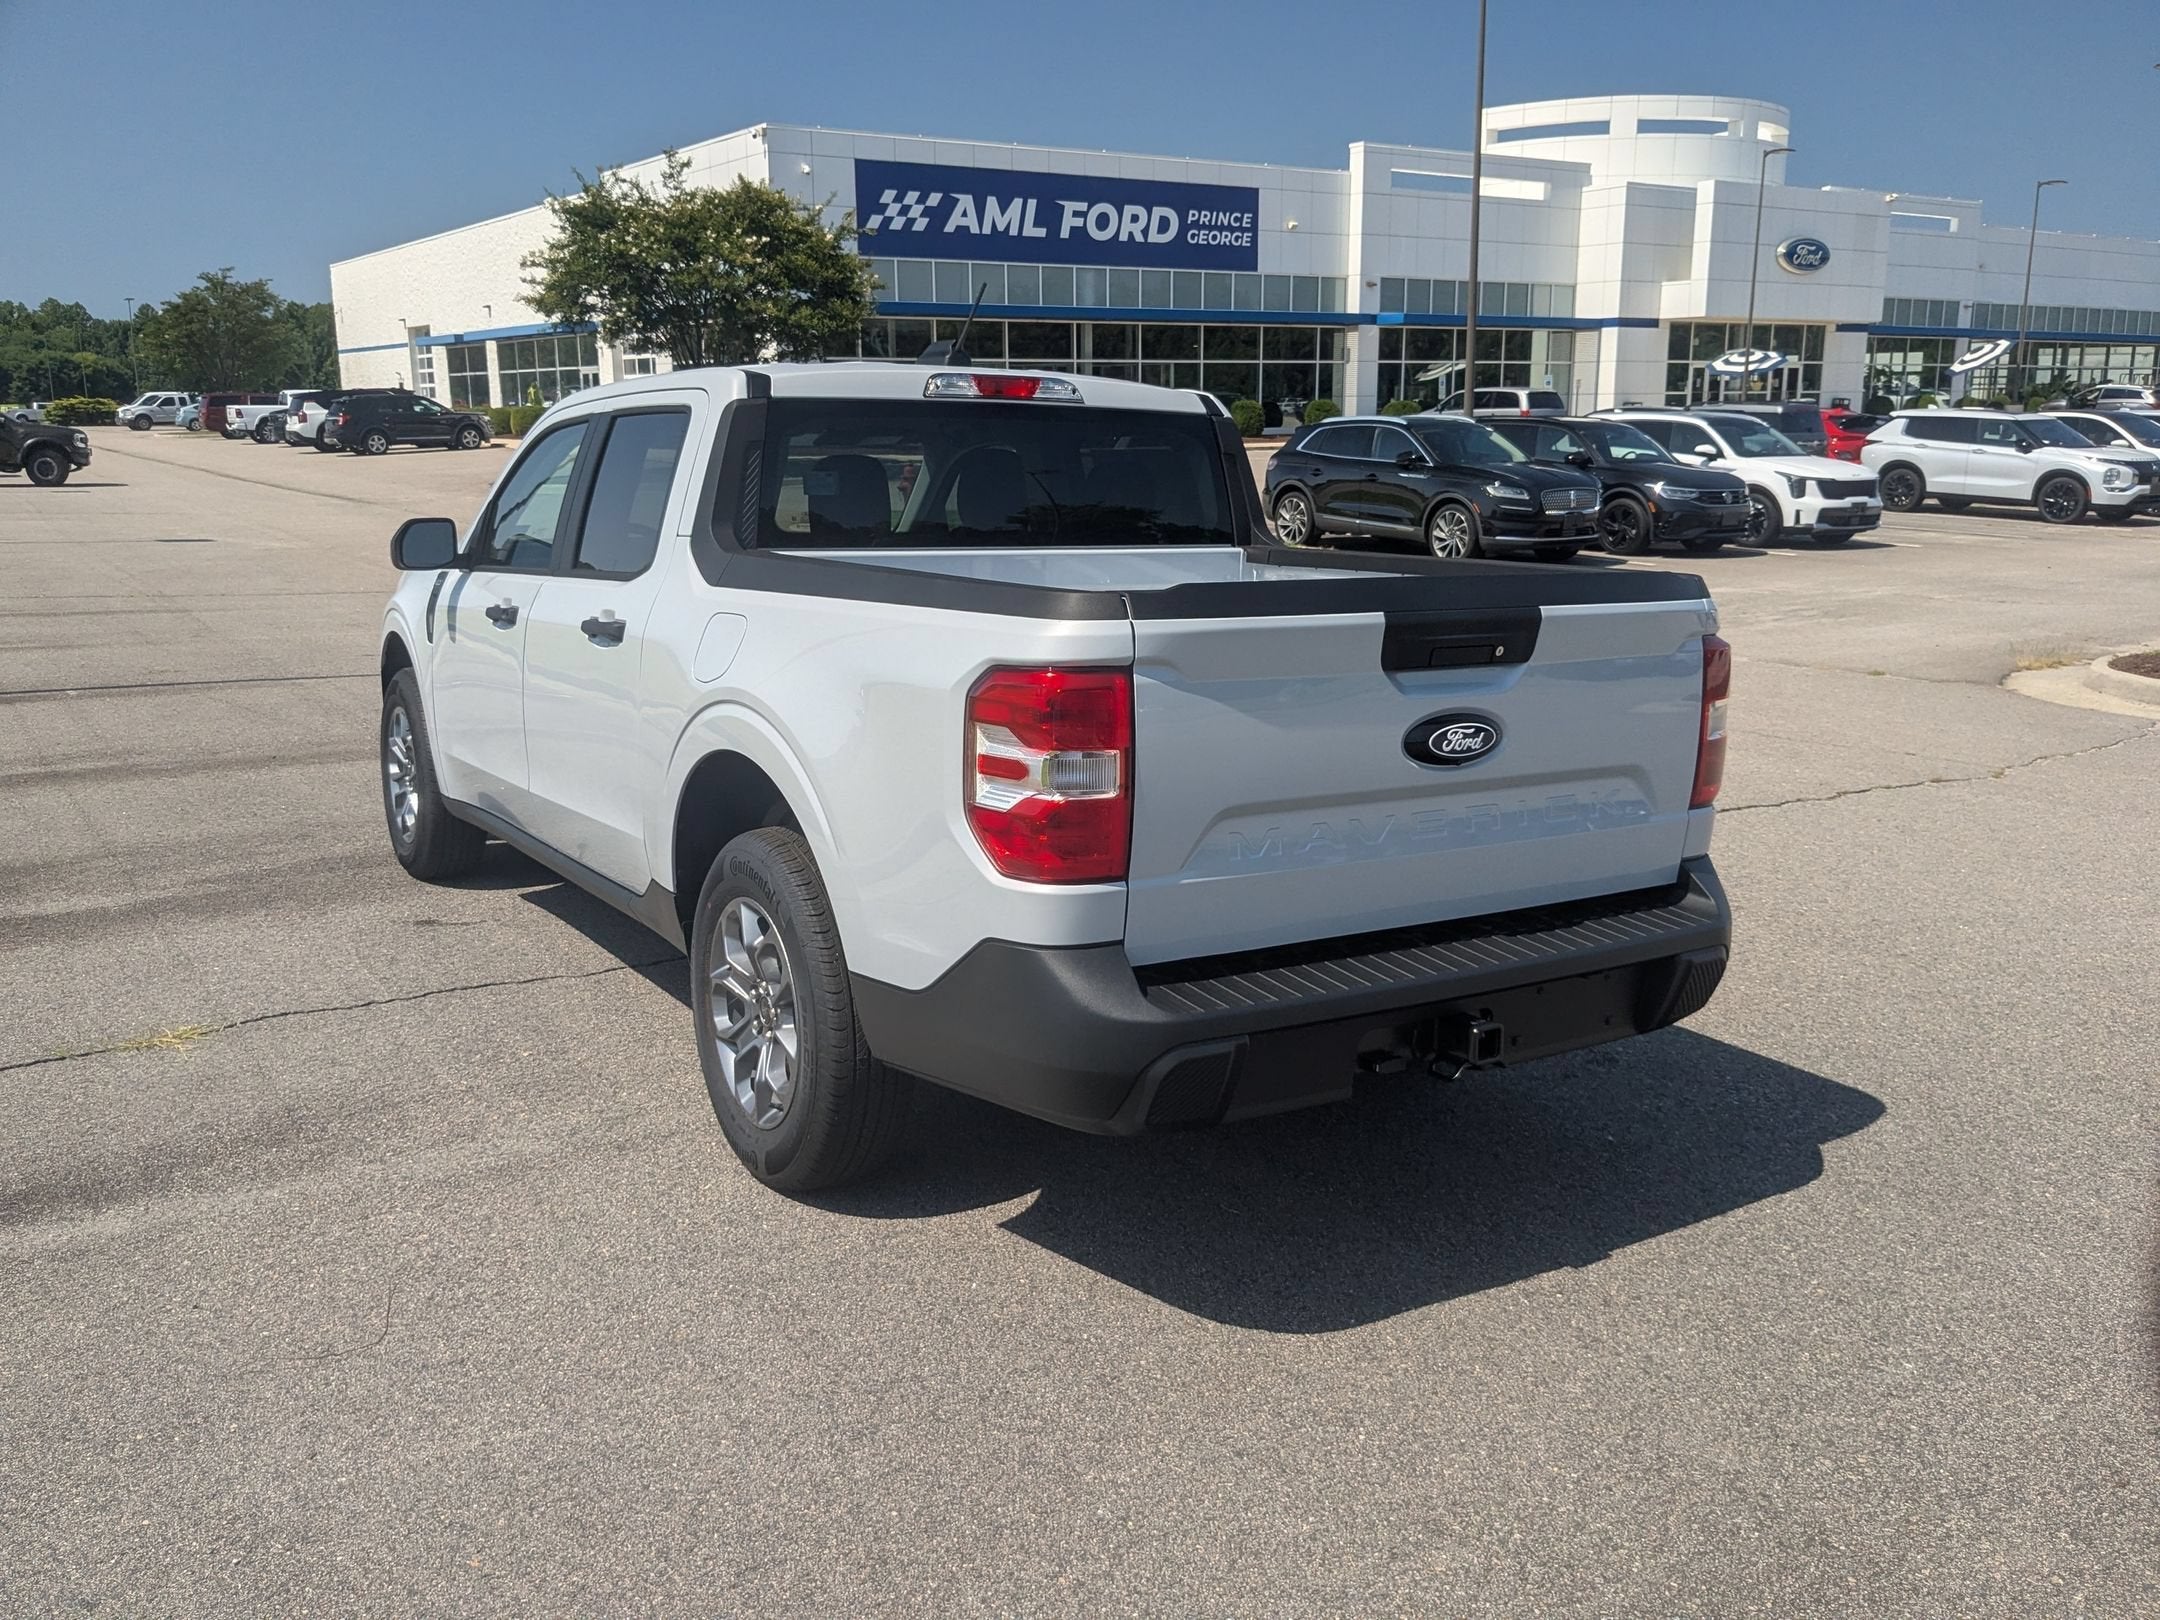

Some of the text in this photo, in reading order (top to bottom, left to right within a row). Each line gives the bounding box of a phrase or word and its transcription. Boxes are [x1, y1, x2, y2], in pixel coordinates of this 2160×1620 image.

[943, 193, 1179, 243] AML FORD
[1187, 209, 1253, 228] PRINCE
[1187, 229, 1253, 247] GEORGE
[1792, 244, 1823, 265] Ford
[1442, 728, 1484, 752] Ford
[1227, 789, 1624, 861] MAVERICK
